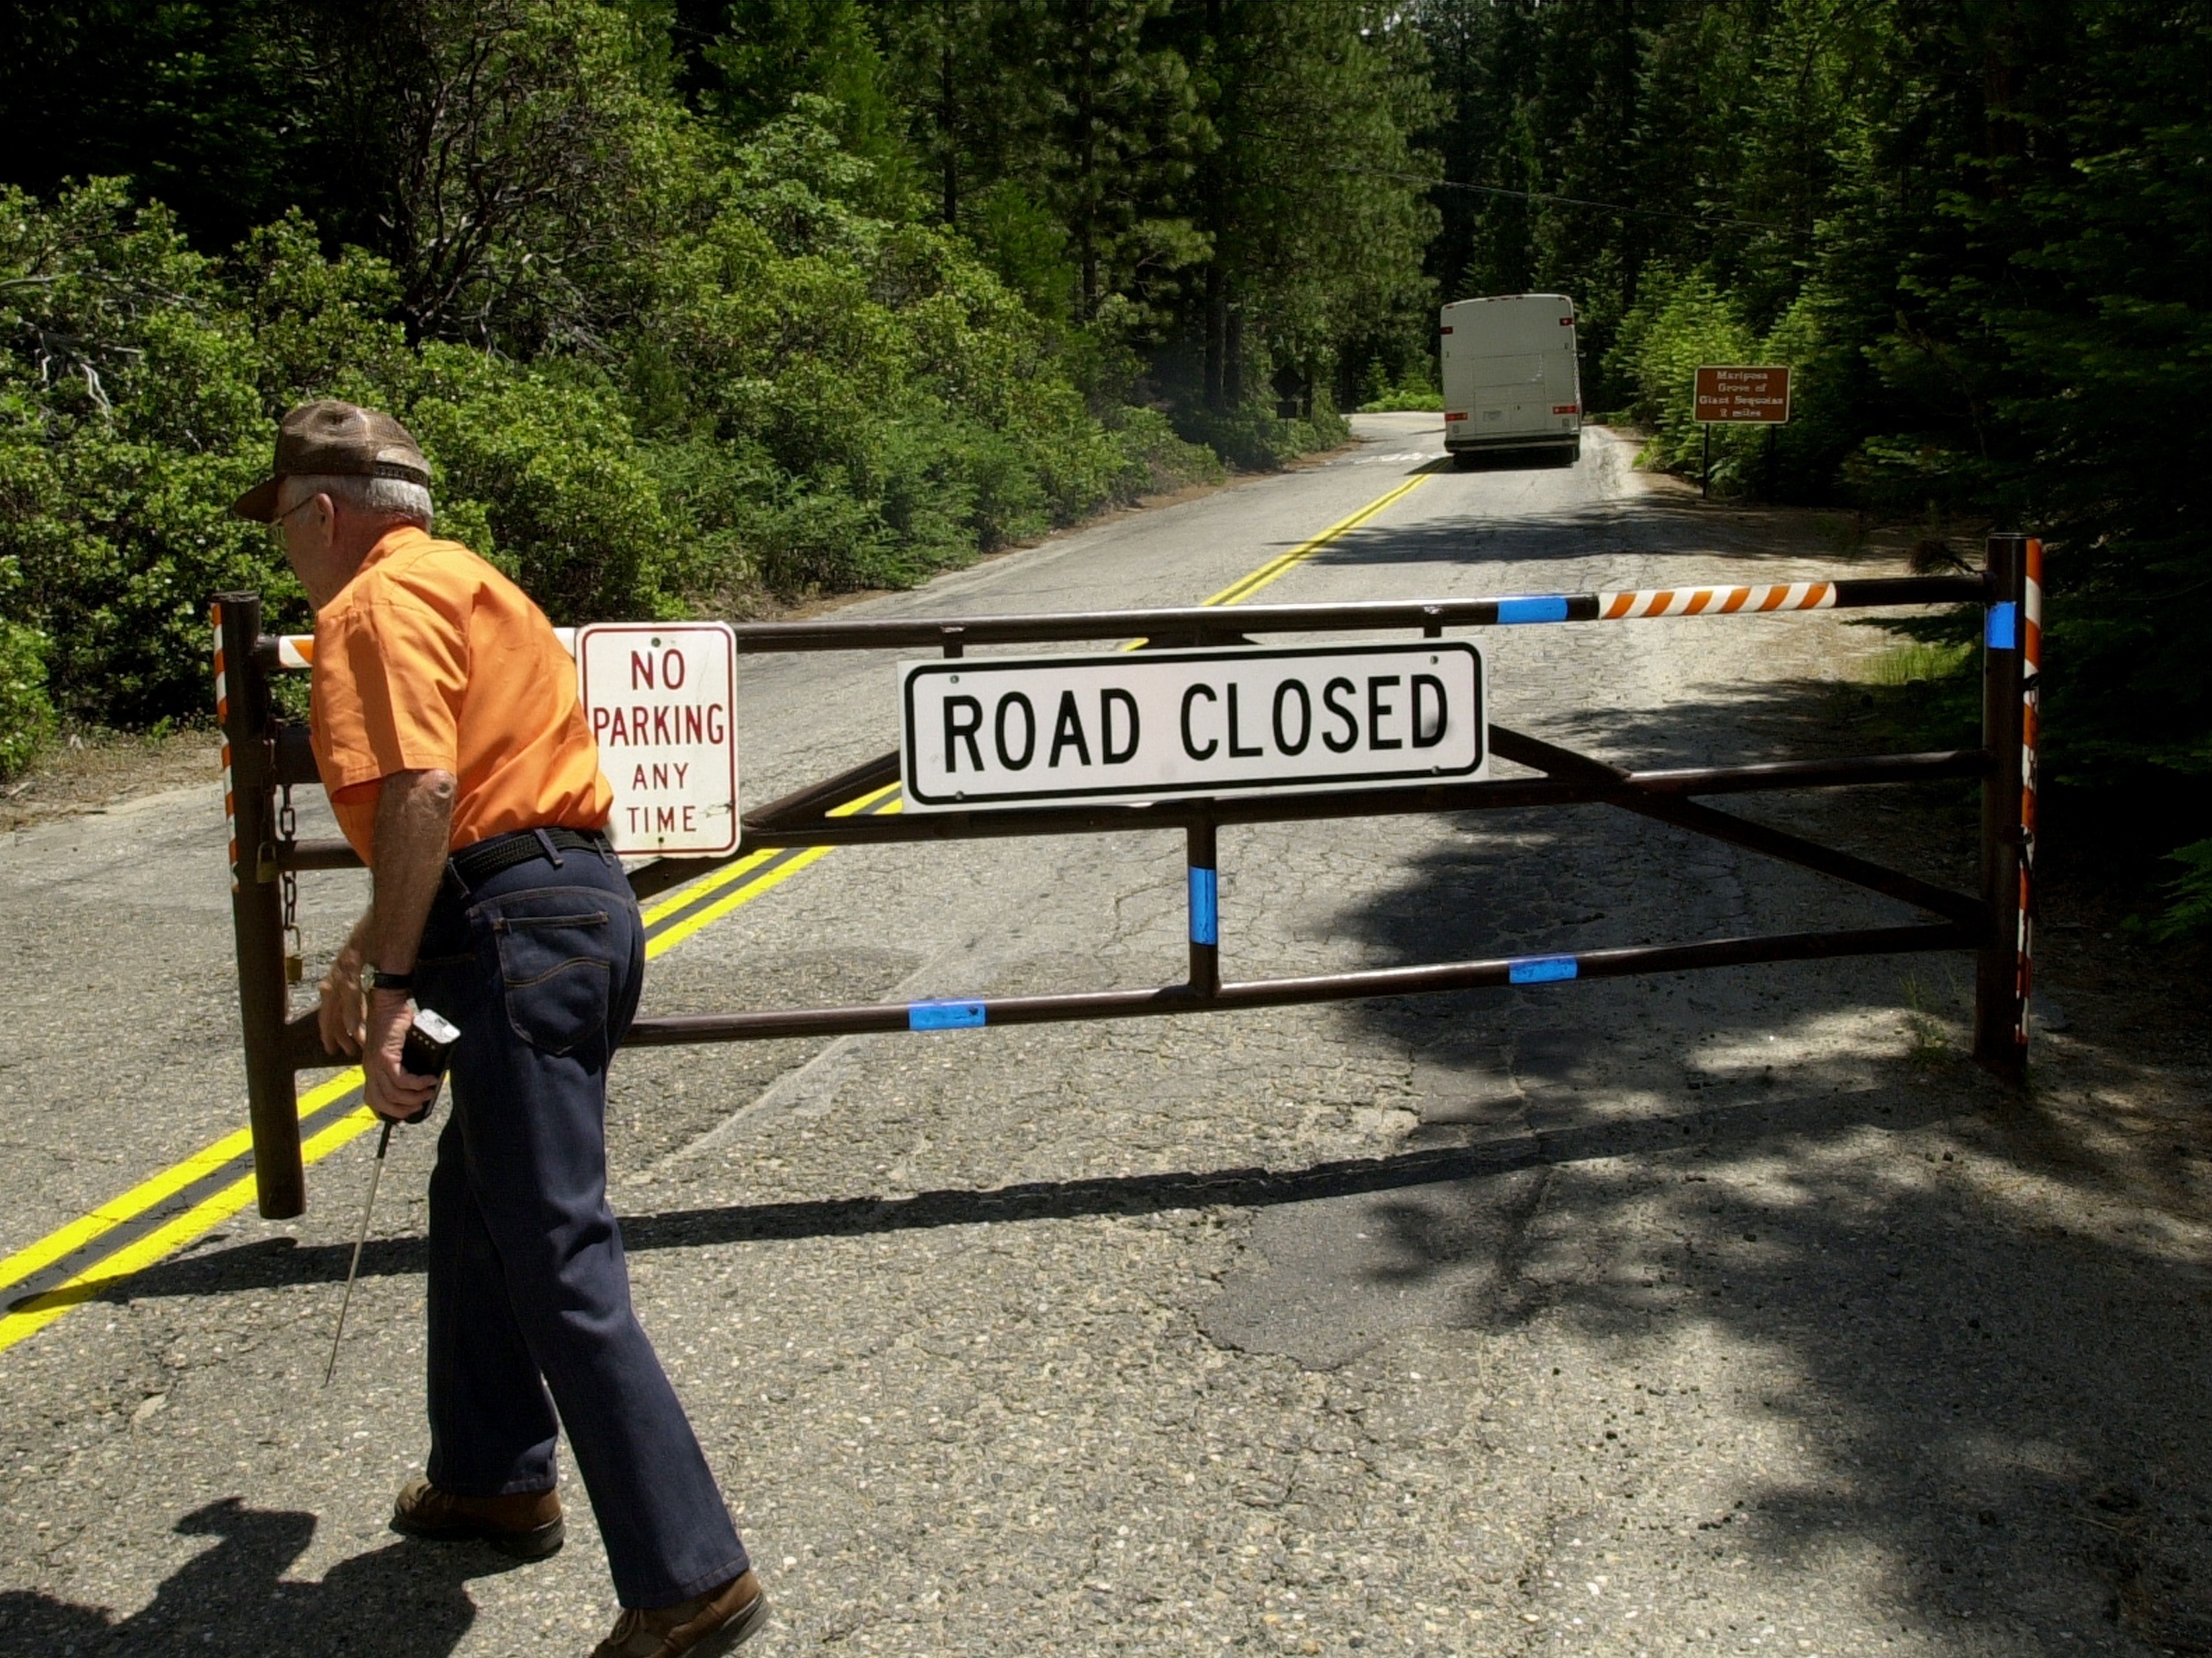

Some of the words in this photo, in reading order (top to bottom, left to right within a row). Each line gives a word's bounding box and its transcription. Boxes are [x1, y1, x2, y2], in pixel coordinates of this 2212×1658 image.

[1716, 371, 1768, 381] Mariposa
[1718, 383, 1749, 392] Grove
[1755, 383, 1766, 392] of
[1699, 395, 1729, 405] Giant
[1734, 395, 1783, 406] Sequoias
[1733, 408, 1761, 417] miles
[631, 649, 685, 690] NO
[593, 703, 724, 747] PARKING
[943, 688, 1141, 774] ROAD
[1180, 673, 1449, 762] CLOSED
[632, 762, 689, 791] ANY
[626, 805, 696, 834] TIME
